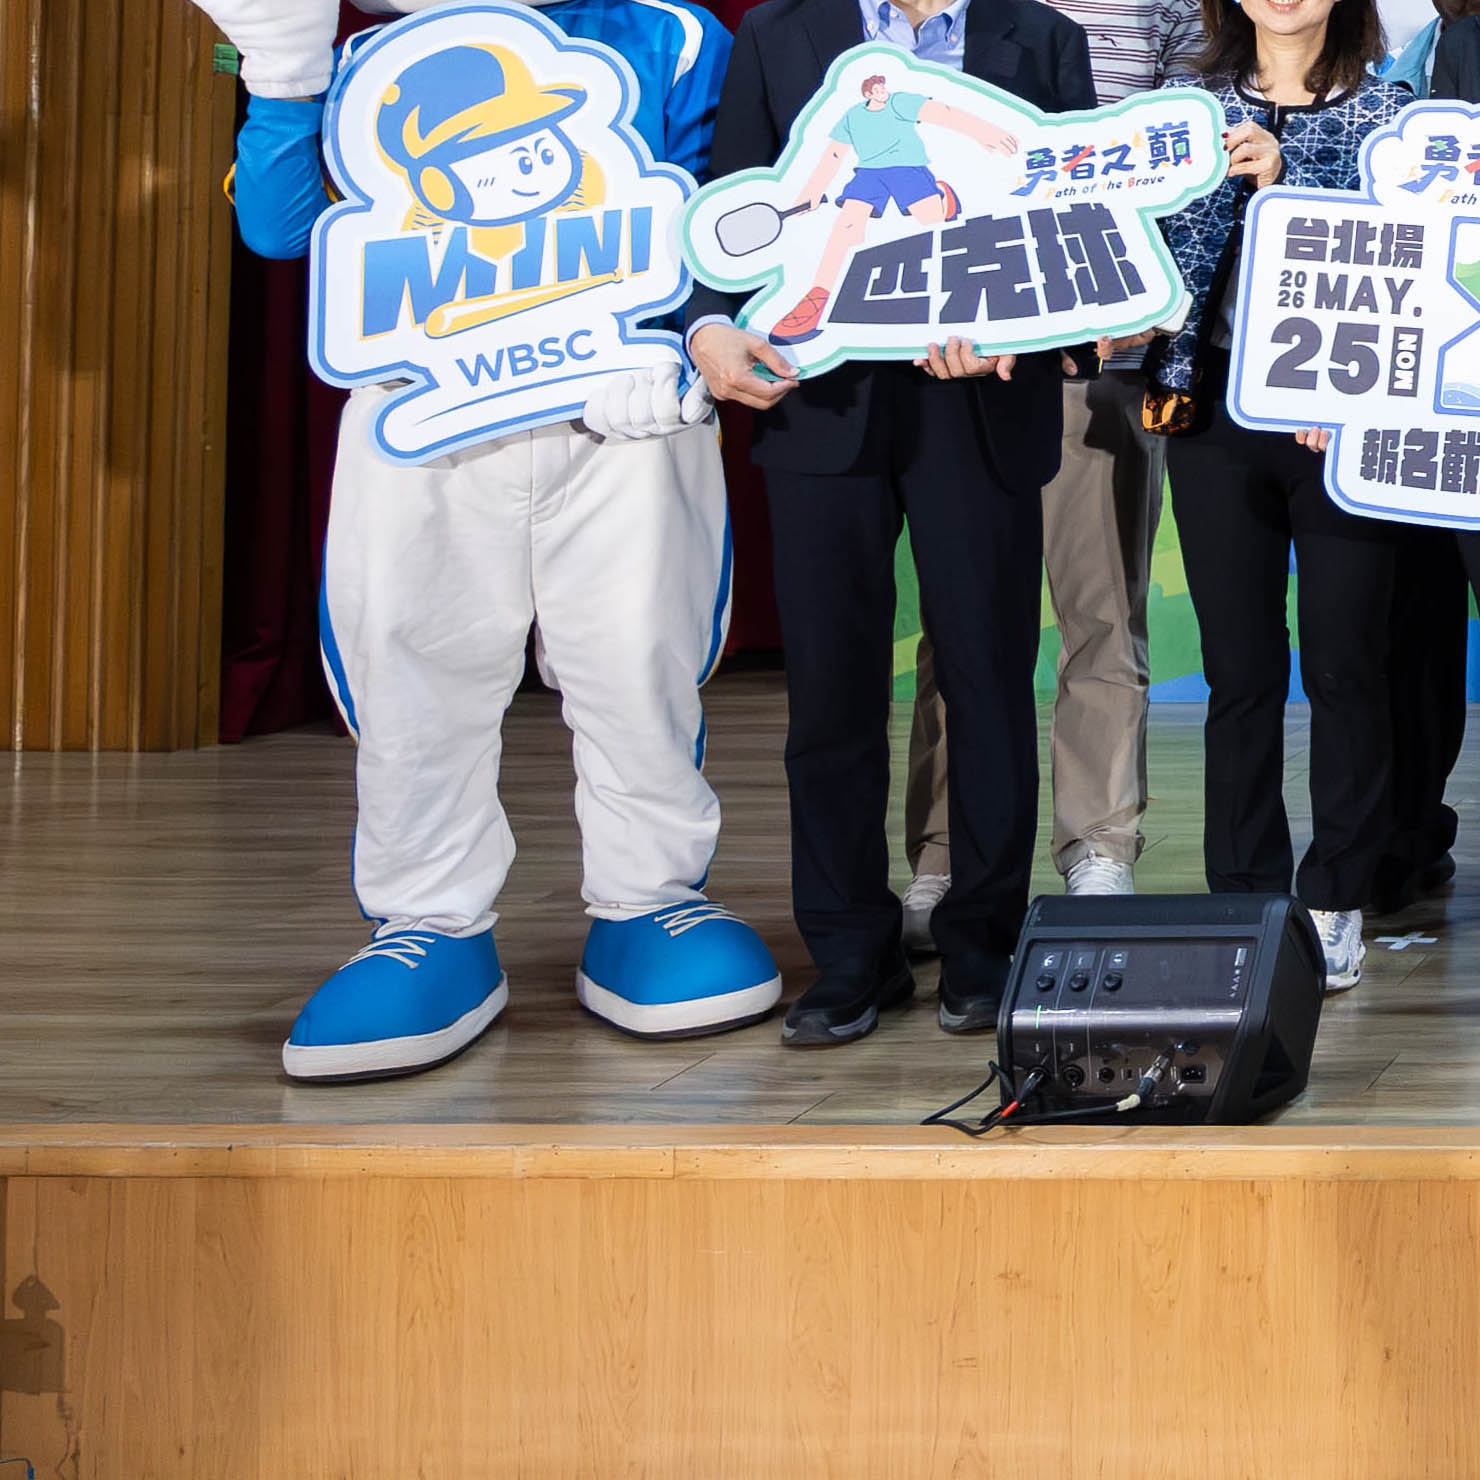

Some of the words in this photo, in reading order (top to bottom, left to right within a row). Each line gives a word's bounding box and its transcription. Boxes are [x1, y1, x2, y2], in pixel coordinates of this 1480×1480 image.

[1009, 120, 1193, 197] 勇者之巔
[1082, 183, 1097, 194] of
[1128, 175, 1165, 188] Brave
[827, 203, 1146, 325] 匹克球
[1284, 217, 1425, 270] 台北場
[358, 206, 654, 341] MINI
[1277, 289, 1305, 309] 26
[1279, 270, 1307, 289] 20
[1313, 272, 1423, 318] MAY.
[455, 329, 598, 388] WBSC
[1265, 317, 1381, 395] 25
[1394, 333, 1417, 391] MON
